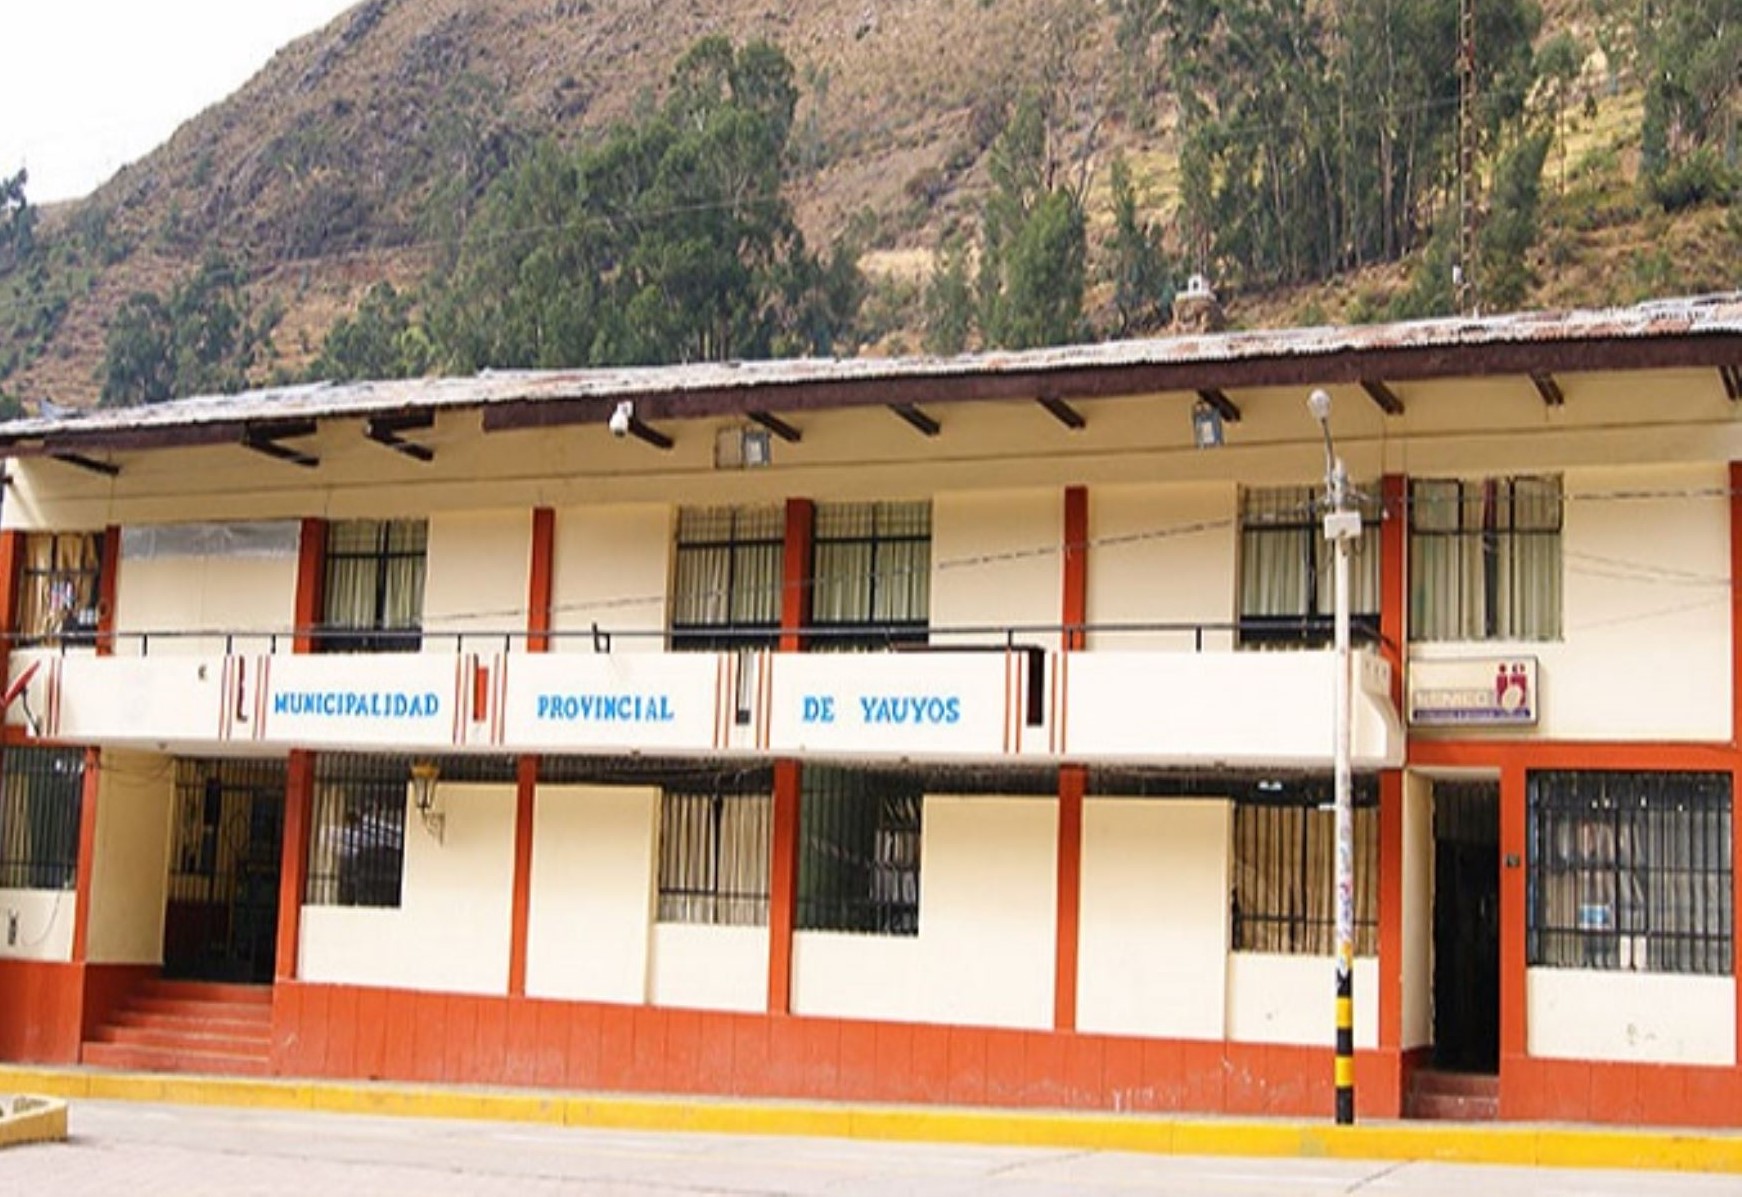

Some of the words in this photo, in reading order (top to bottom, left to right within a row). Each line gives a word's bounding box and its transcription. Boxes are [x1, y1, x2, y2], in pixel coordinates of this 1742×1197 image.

[274, 692, 439, 717] MUNICIPALIDAD
[537, 694, 674, 720] PROVINCIAL
[803, 696, 834, 722] DE
[860, 697, 960, 723] YAUYOS
